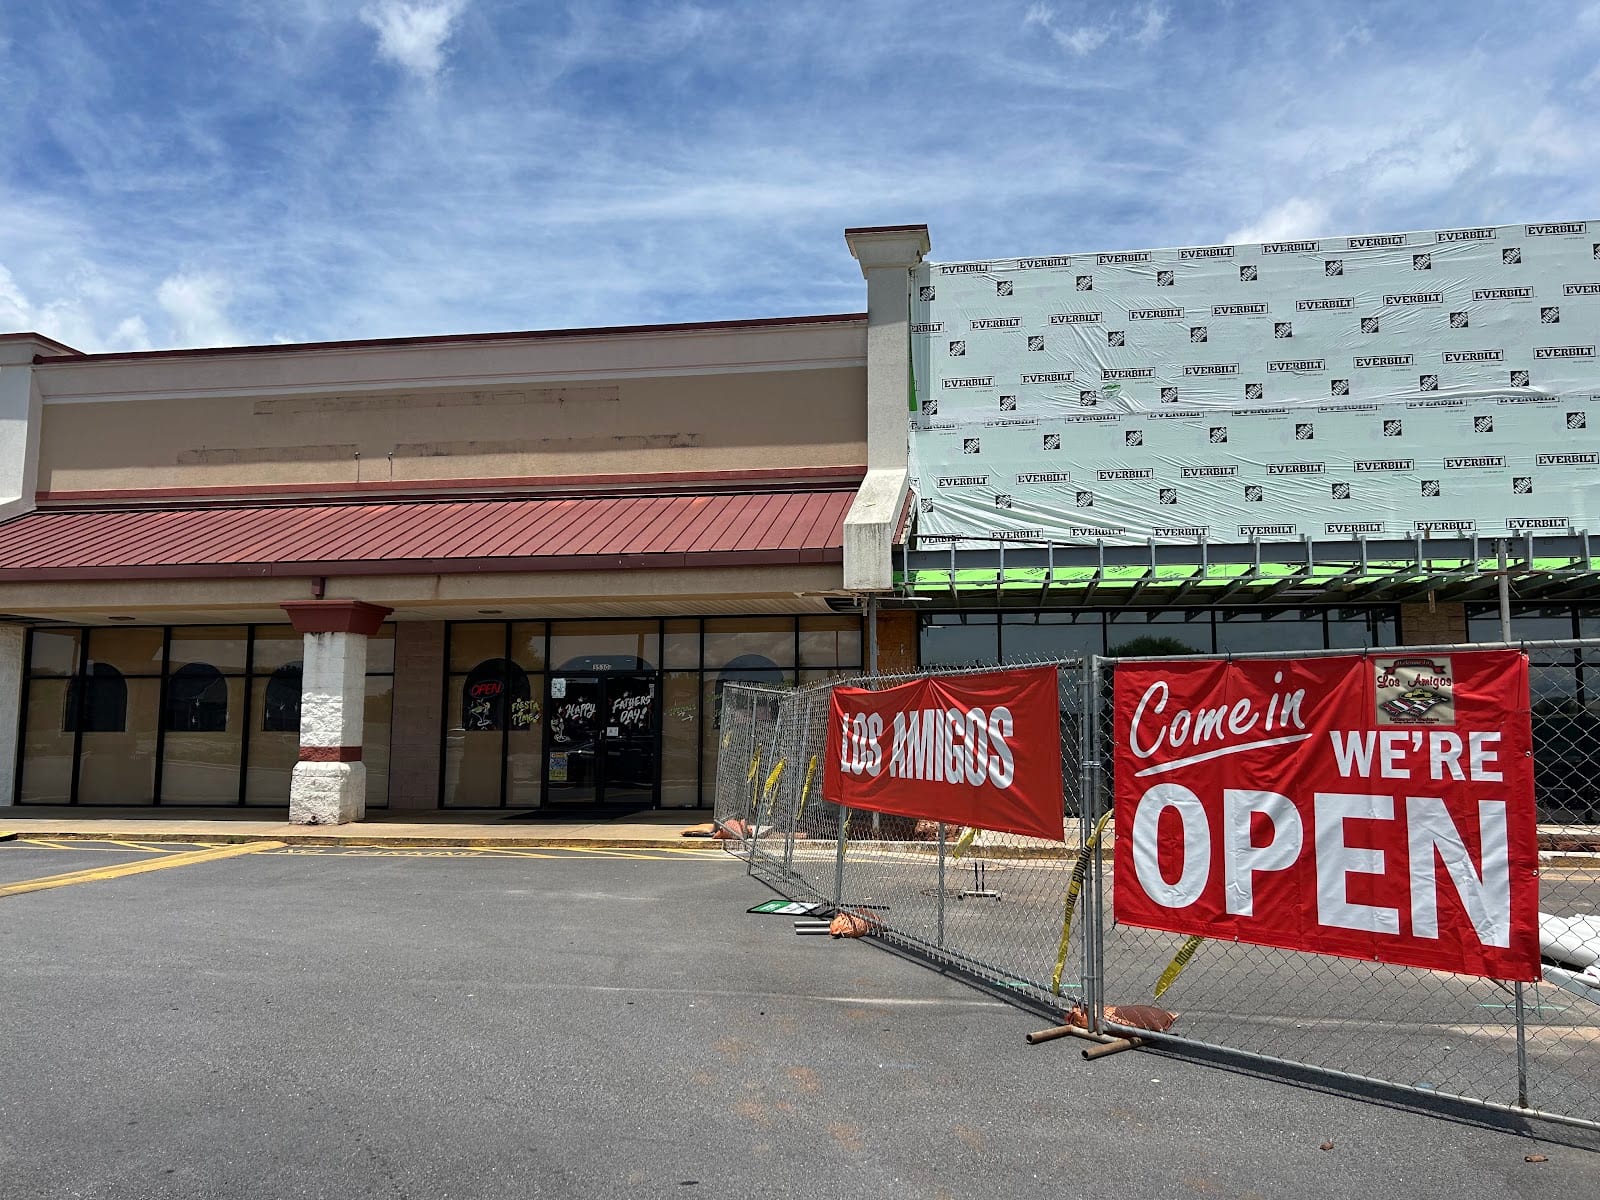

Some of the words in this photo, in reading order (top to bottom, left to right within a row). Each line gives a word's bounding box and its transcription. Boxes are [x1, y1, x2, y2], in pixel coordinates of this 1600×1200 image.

[1528, 224, 1584, 235] EVERBILT
[1438, 230, 1494, 242] EVERBILT
[1349, 236, 1404, 248] EVERBILT
[1180, 248, 1232, 258] EVERBILT
[1264, 242, 1318, 254] EVERBILT
[1020, 258, 1069, 268] EVERBILT
[1099, 253, 1150, 264] EVERBILT
[942, 264, 990, 275] EVERBILT
[1386, 293, 1441, 305] EVERBILT
[1474, 288, 1532, 300] EVERBILT
[1214, 304, 1266, 315] EVERBILT
[1298, 298, 1352, 310] EVERBILT
[1050, 314, 1100, 324] EVERBILT
[1131, 308, 1182, 320] EVERBILT
[911, 323, 942, 332] ERBILT
[972, 318, 1020, 329] EVERBILT
[1444, 351, 1502, 362] EVERBILT
[1536, 347, 1594, 358] EVERBILT
[1269, 360, 1324, 371] EVERBILT
[1356, 356, 1412, 367] EVERBILT
[1103, 368, 1154, 380] EVERBILT
[1184, 364, 1238, 376] EVERBILT
[944, 378, 994, 388] EVERBILT
[1022, 373, 1072, 384] EVERBILT
[1446, 457, 1504, 468] EVERBILT
[1538, 454, 1597, 464] EVERBILT
[1268, 464, 1324, 474] EVERBILT
[1356, 460, 1412, 471] EVERBILT
[1098, 469, 1152, 480] EVERBILT
[1182, 466, 1236, 477] EVERBILT
[938, 476, 988, 487] EVERBILT
[1018, 473, 1068, 484] EVERBILT
[1327, 522, 1382, 532] EVERBILT
[1416, 520, 1474, 530] EVERBILT
[1509, 518, 1566, 528] EVERBILT
[992, 530, 1040, 539] EVERBILT
[1154, 528, 1208, 536] EVERBILT
[1240, 524, 1294, 535] EVERBILT
[1376, 674, 1400, 688] Los
[1408, 674, 1452, 690] Amigos
[471, 682, 502, 696] OPEN
[612, 696, 651, 714] FATHERS
[565, 703, 597, 719] HAPPY
[620, 706, 648, 725] DAY!
[1129, 680, 1259, 758] Come
[1265, 671, 1306, 730] in
[841, 712, 884, 777] LOS
[889, 706, 1015, 790] AMIGOS
[1330, 730, 1504, 782] WE'RE
[1132, 783, 1511, 949] OPEN
